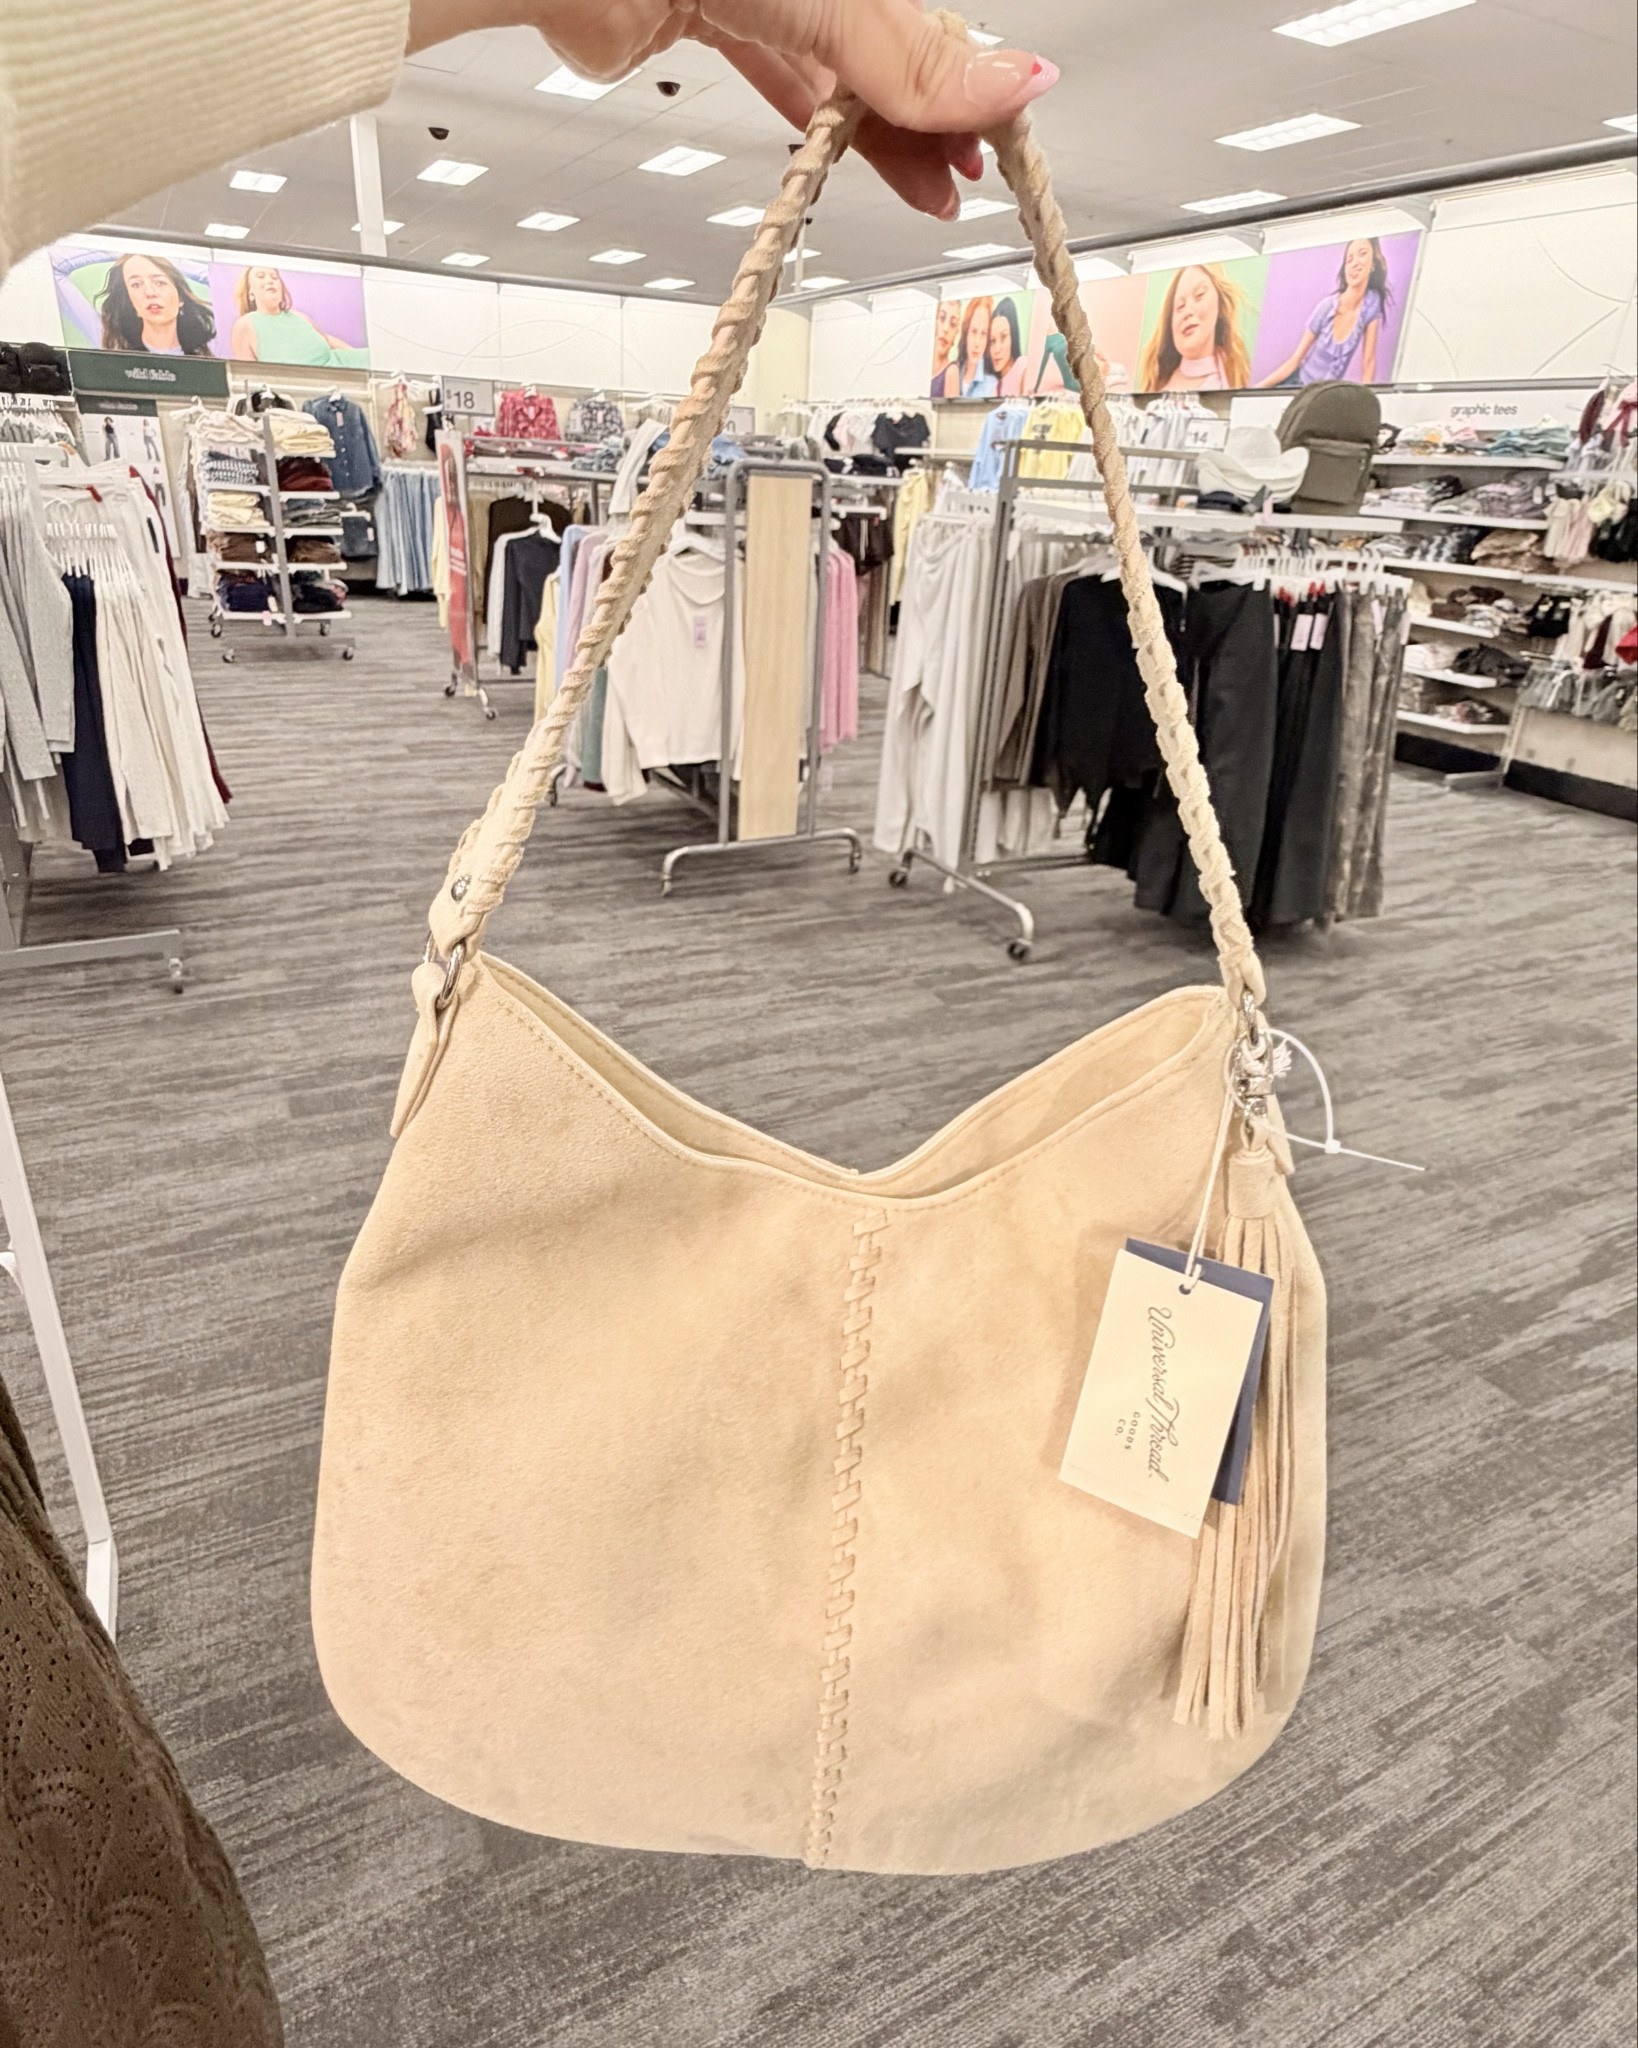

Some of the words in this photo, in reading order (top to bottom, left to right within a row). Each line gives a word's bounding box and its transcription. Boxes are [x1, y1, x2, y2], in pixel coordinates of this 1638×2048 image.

[1450, 403, 1491, 418] graphic
[1493, 404, 1518, 415] tees
[1148, 1306, 1176, 1411] Universal
[1124, 1411, 1141, 1450] GOODS
